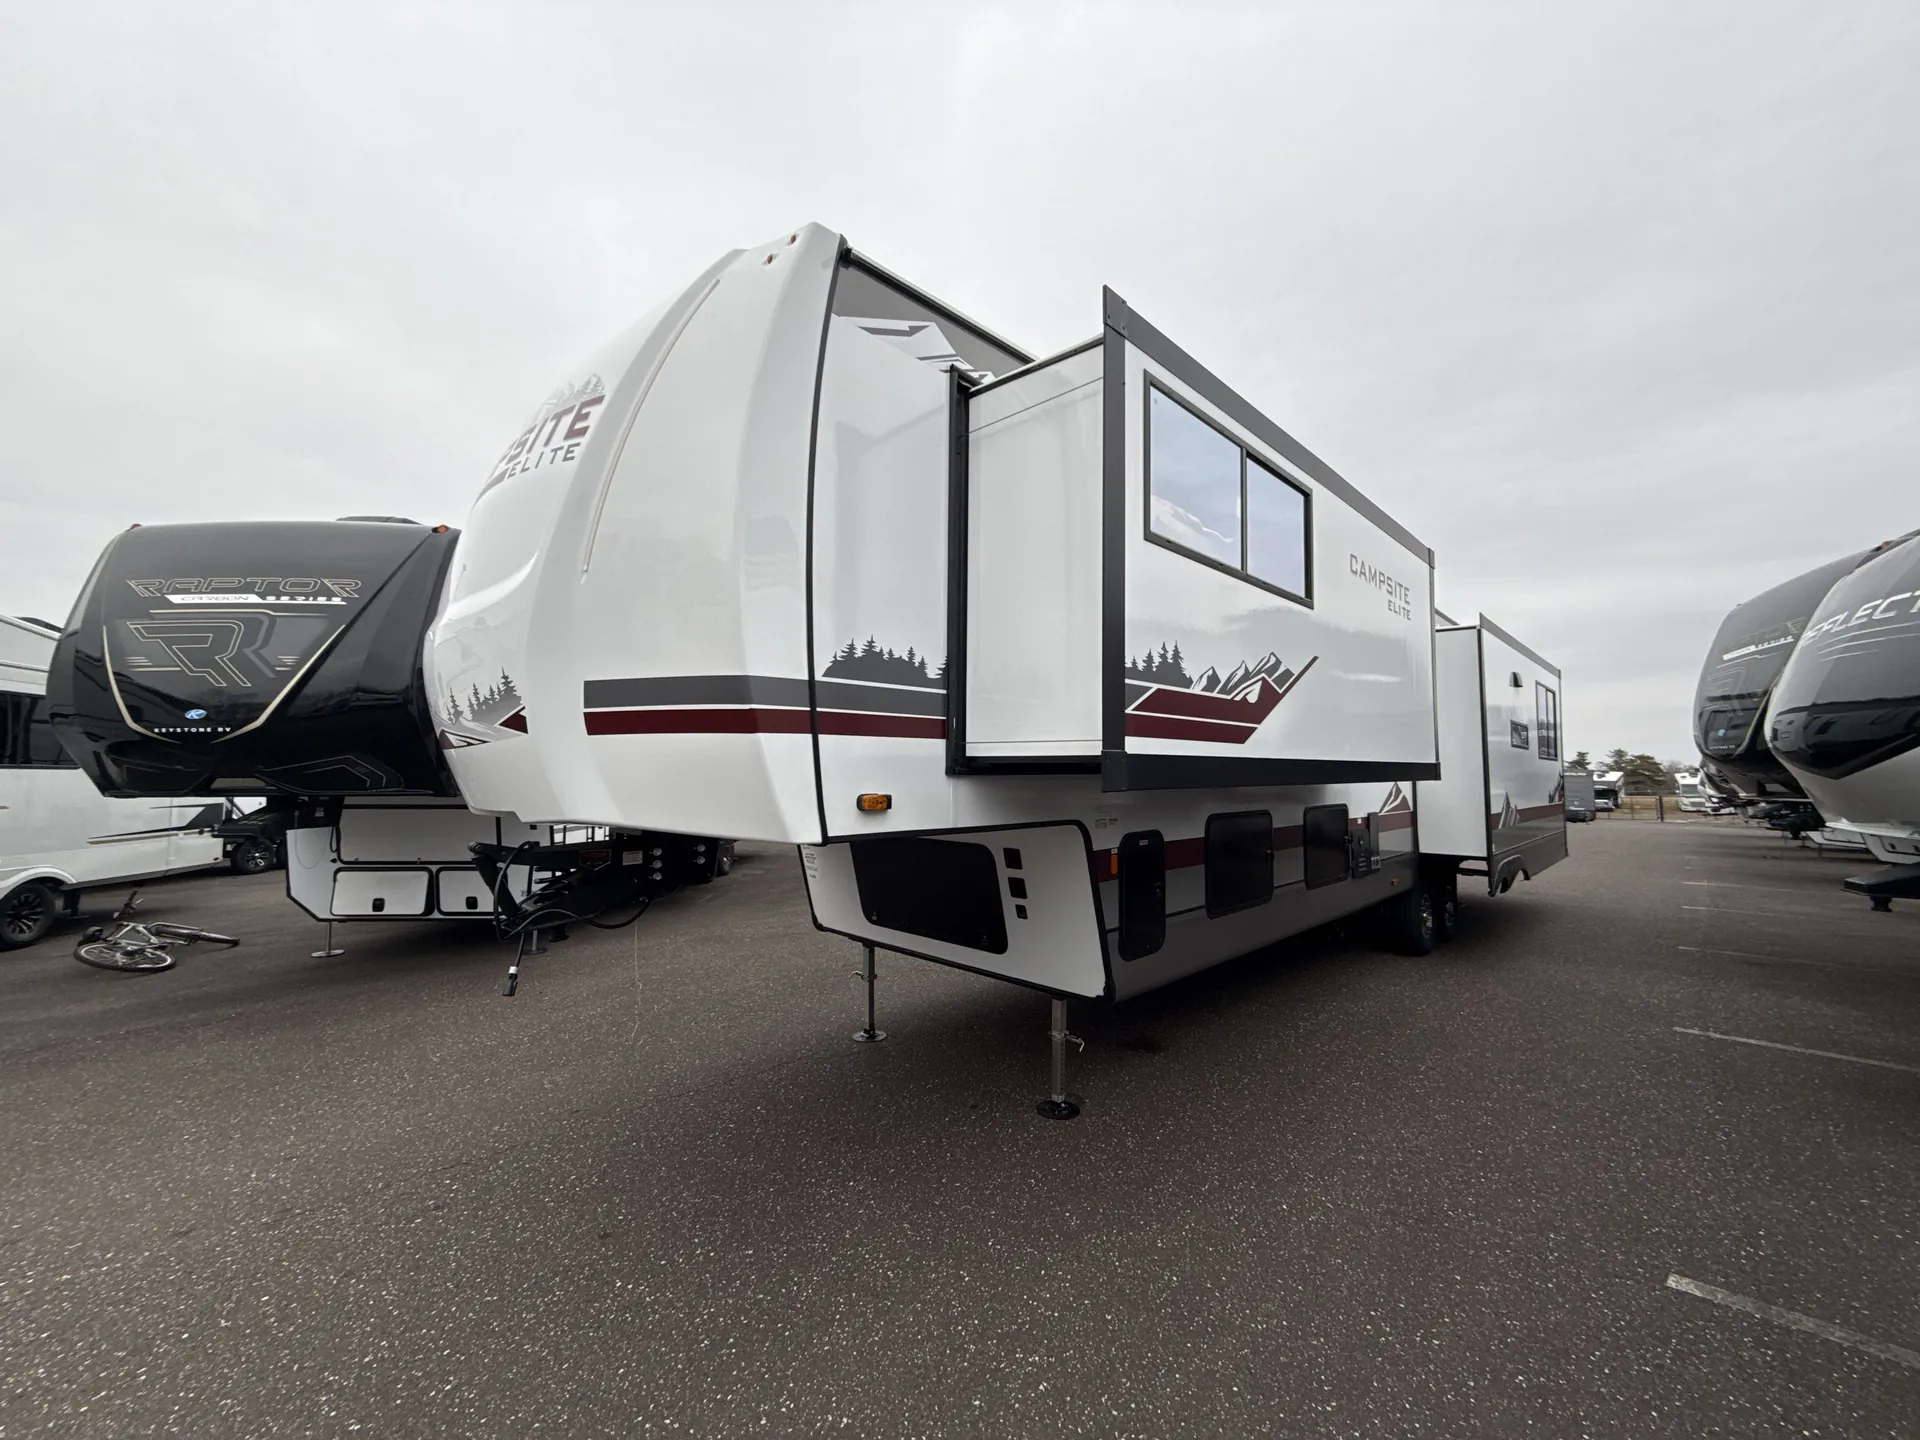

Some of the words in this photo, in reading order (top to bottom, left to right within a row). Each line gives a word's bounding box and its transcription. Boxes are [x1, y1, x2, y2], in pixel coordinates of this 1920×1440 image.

[507, 442, 581, 479] ELITE
[126, 577, 362, 598] RAPTOR
[1350, 553, 1410, 605] CAMPSITE
[1388, 599, 1411, 621] ELITE
